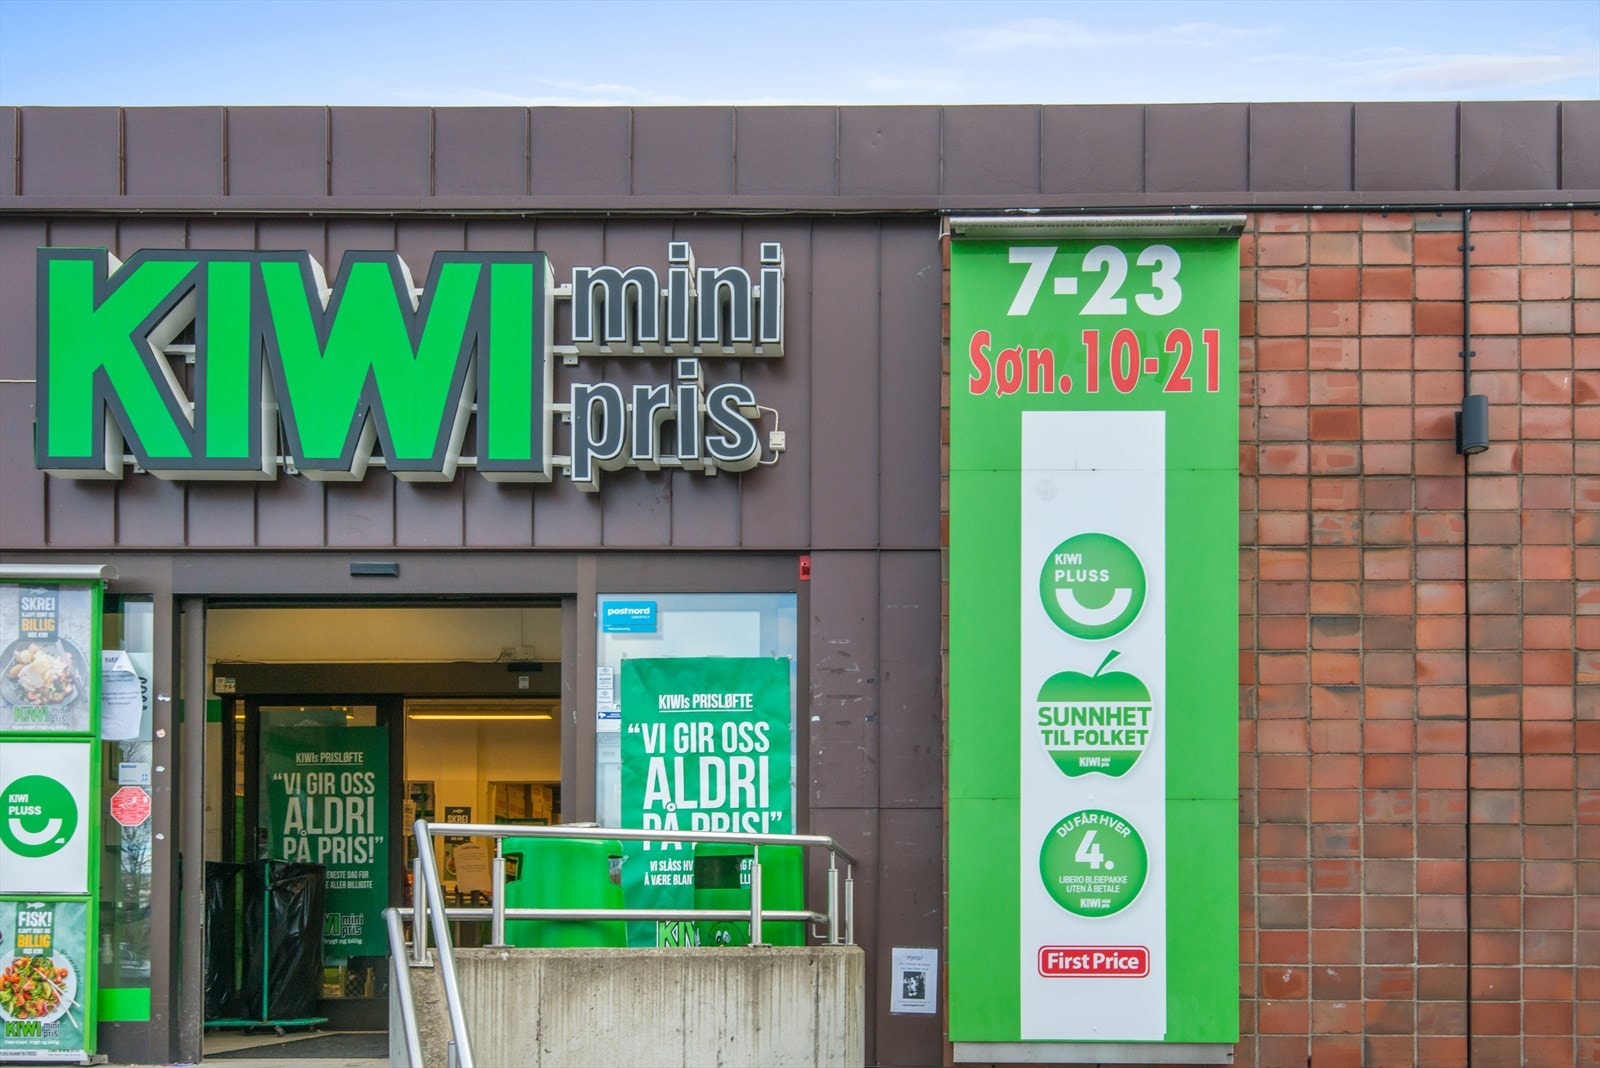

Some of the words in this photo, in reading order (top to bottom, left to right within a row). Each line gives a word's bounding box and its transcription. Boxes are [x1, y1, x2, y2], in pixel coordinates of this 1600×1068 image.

[1006, 244, 1183, 316] 7-23
[571, 241, 783, 345] mini
[35, 246, 549, 476] KIWI
[969, 329, 1073, 398] Søn.
[1082, 328, 1220, 394] 10-21
[570, 358, 759, 482] pris
[1055, 553, 1082, 565] KIWI
[1055, 569, 1110, 582] PLUSS
[21, 597, 56, 610] SKREI
[607, 606, 651, 616] postnord
[21, 618, 56, 631] BILLIG
[659, 694, 690, 709] KIWIs
[692, 693, 753, 709] PRISLØFTE
[13, 705, 49, 722] KIWI
[1038, 706, 1152, 726] SUNNHET
[673, 722, 714, 753] GIR
[721, 721, 770, 752] OSS
[1041, 729, 1070, 745] TIL
[1074, 729, 1149, 746] FOLKET
[296, 752, 319, 763] KIWIs
[320, 752, 364, 763] PRISLØFTE
[1079, 757, 1101, 767] KIWI
[306, 772, 335, 795] GIR
[341, 772, 375, 795] OSS
[643, 755, 770, 809] ALDRI
[8, 794, 29, 803] KIWI
[8, 806, 42, 815] PLUSS
[283, 797, 375, 835] ALDRI
[447, 814, 468, 823] SKREI
[1056, 820, 1074, 838] DU
[1074, 812, 1098, 827] FÅR
[1099, 814, 1132, 838] HVER
[283, 827, 312, 863] PÅ
[1074, 830, 1115, 870] 4.
[650, 860, 657, 871] VI
[659, 858, 681, 871] SLÅSS
[683, 860, 694, 871] HV
[327, 871, 346, 879] ENESTE
[644, 872, 650, 885] Å
[651, 874, 671, 885] VÆRE
[1059, 875, 1084, 884] LIBERO
[1085, 875, 1128, 884] BLEIEPAKKE
[1066, 885, 1086, 893] UTEN
[1087, 883, 1093, 893] Å
[1094, 885, 1120, 893] BETALE
[1080, 898, 1101, 908] KIWI
[18, 911, 52, 927] FISK!
[341, 913, 364, 925] mini
[341, 926, 362, 938] pris
[17, 934, 51, 948] BILLIG
[1047, 952, 1090, 969] First
[1093, 952, 1139, 969] Price
[5, 1020, 41, 1037] KIWI
[43, 1020, 60, 1029] mini
[43, 1031, 59, 1039] pris
